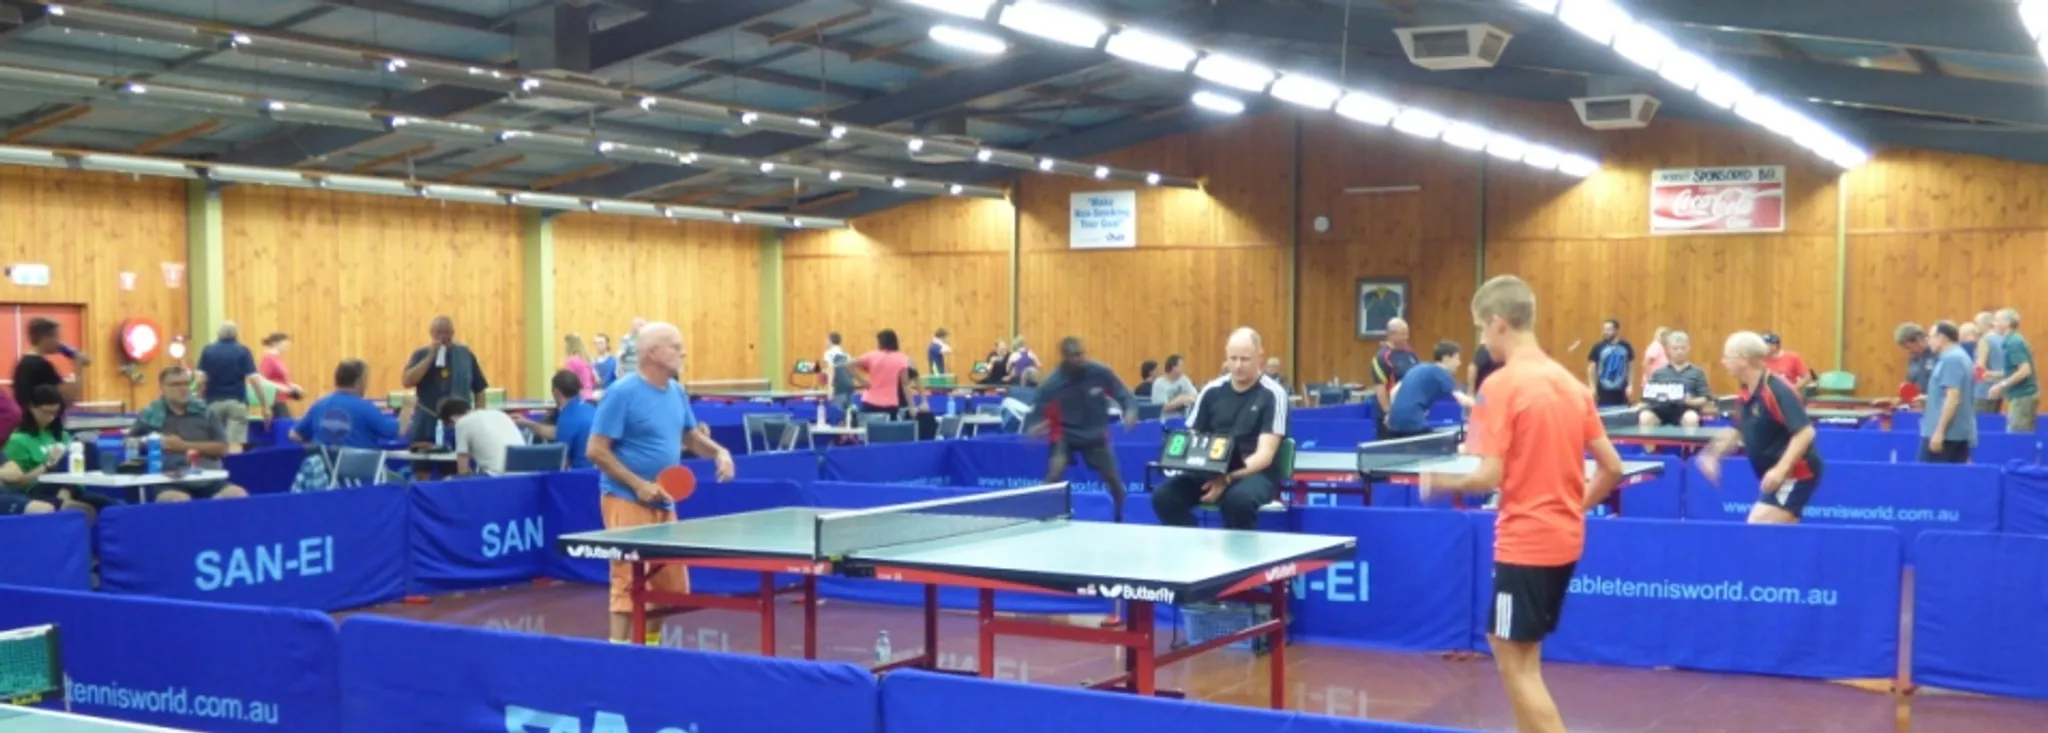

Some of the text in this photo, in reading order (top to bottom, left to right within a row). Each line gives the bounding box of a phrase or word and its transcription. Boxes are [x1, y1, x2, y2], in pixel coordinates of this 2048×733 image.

[194, 536, 334, 591] SAN-EI
[1122, 584, 1175, 605] Butterfly
[1566, 575, 1838, 606] abletennisworld.com.au
